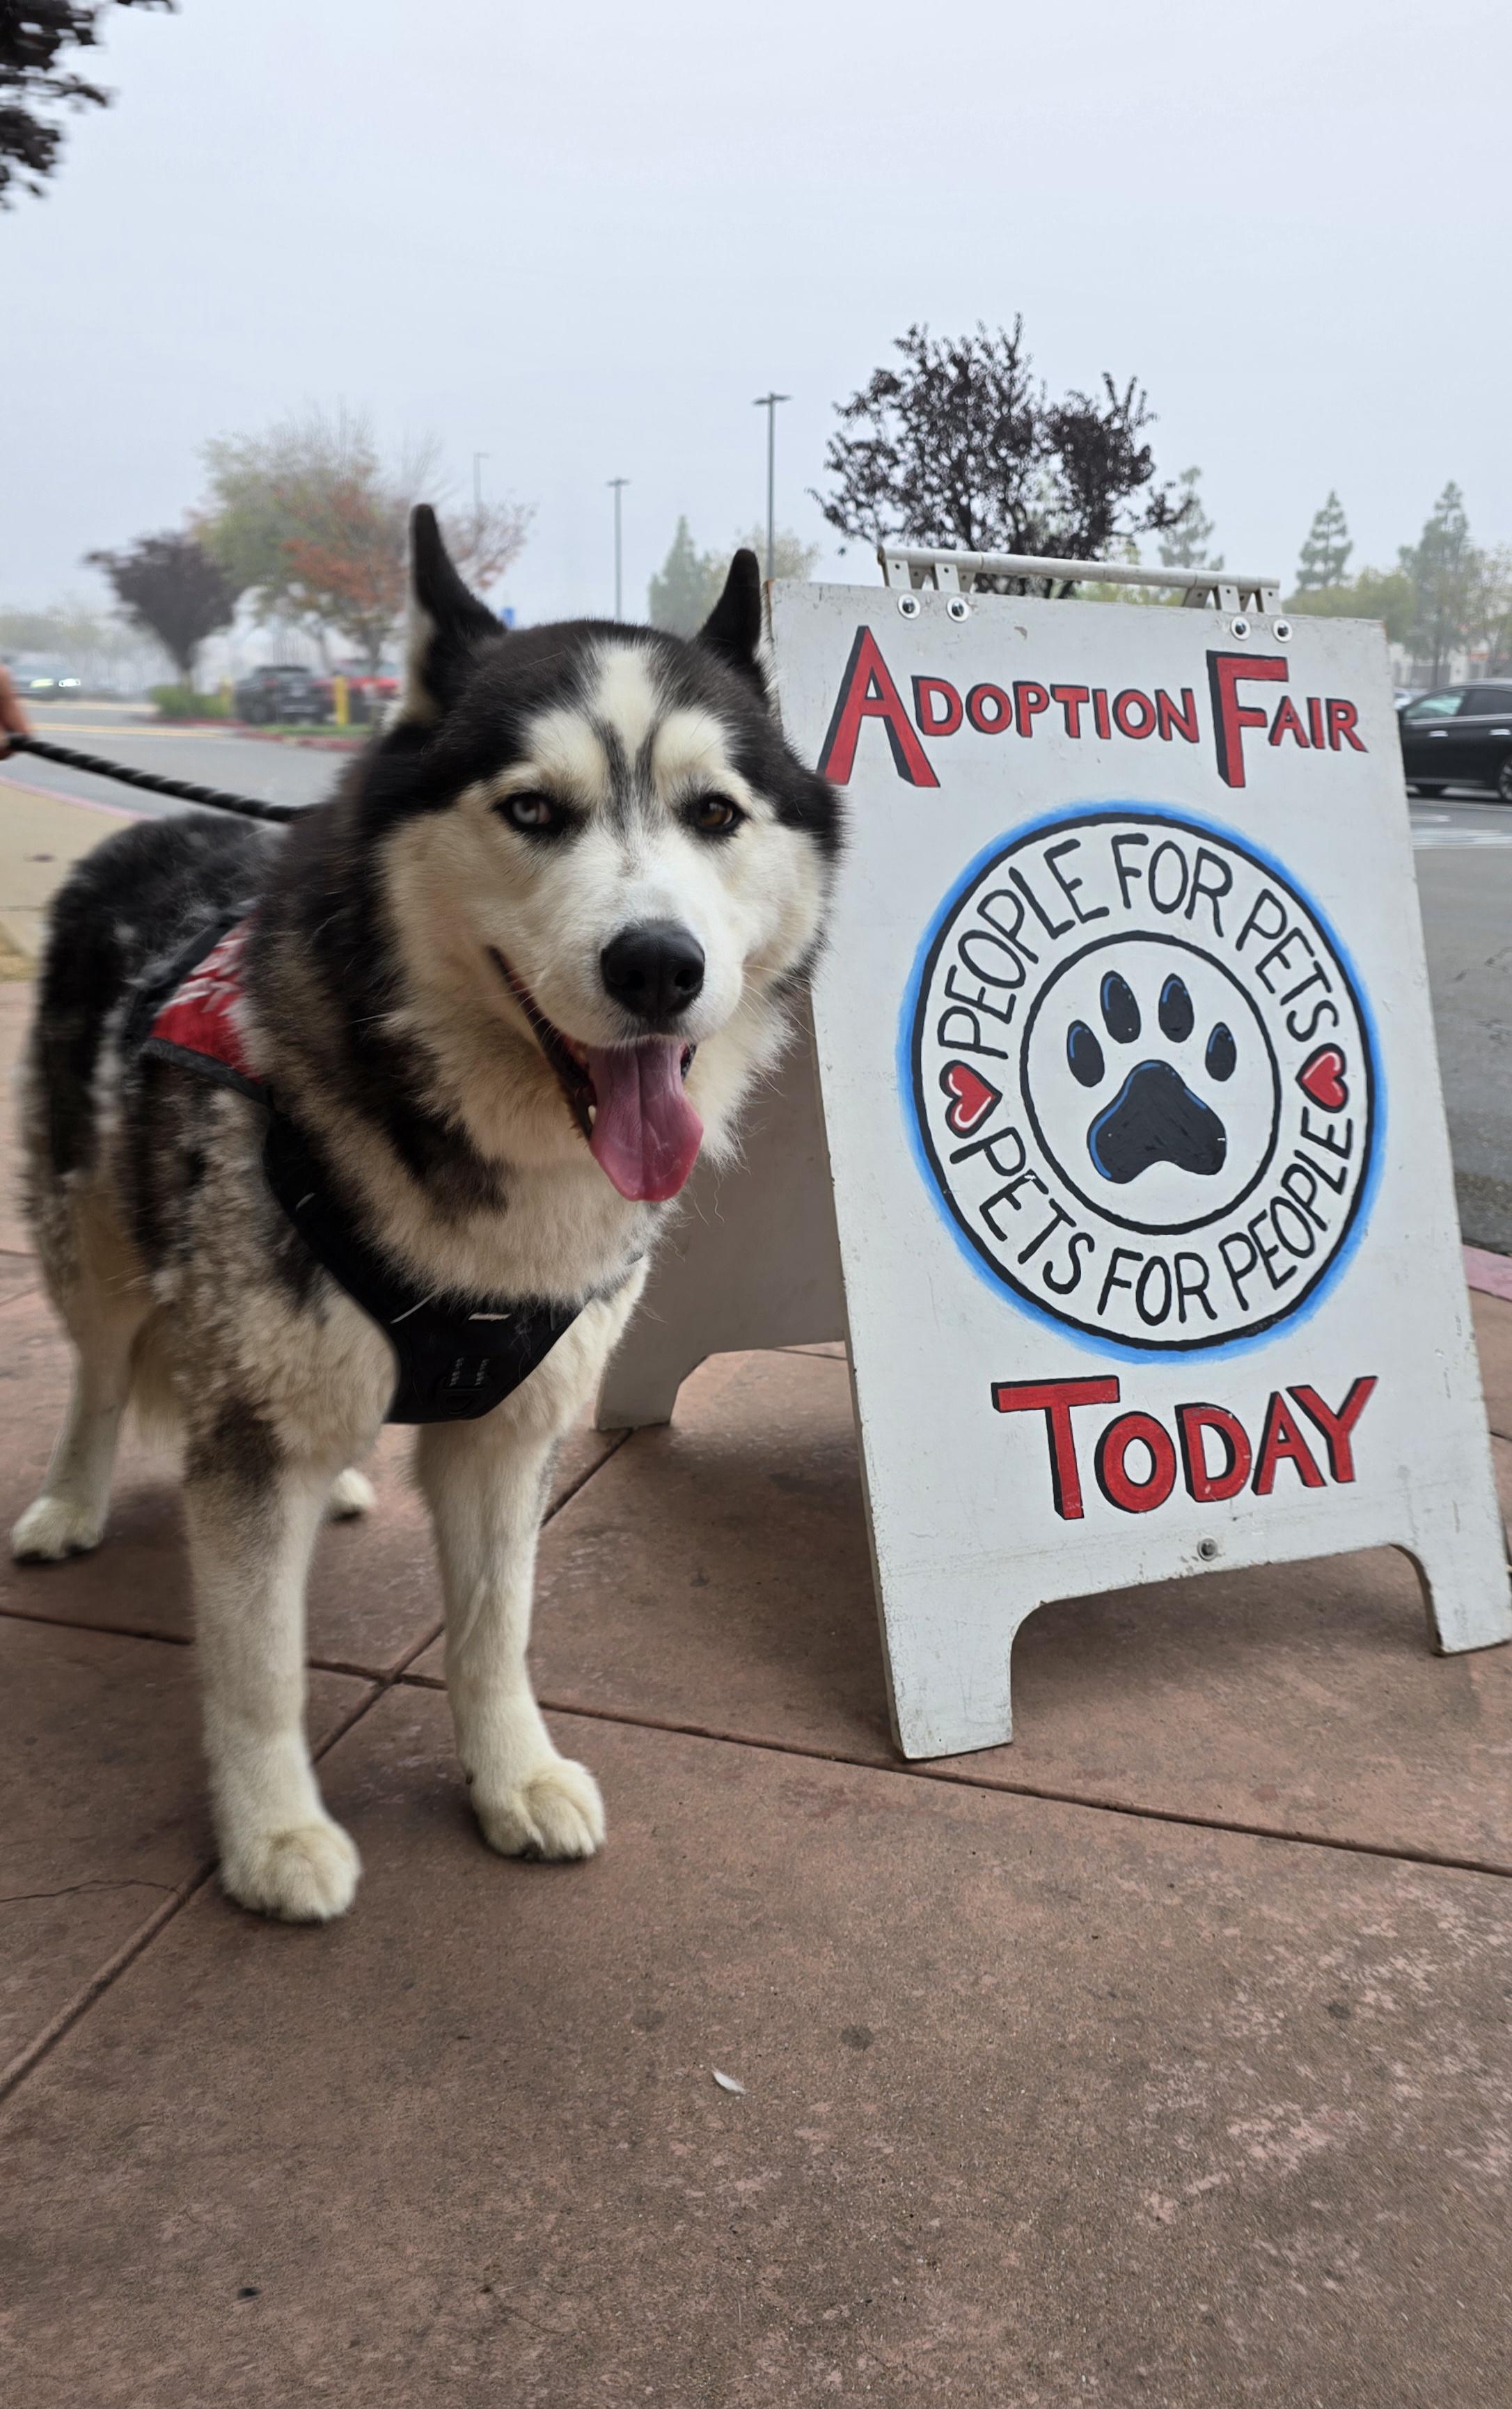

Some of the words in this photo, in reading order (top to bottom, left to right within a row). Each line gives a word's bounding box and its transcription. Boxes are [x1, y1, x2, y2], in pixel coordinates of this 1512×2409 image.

[816, 625, 1200, 787] ADOPTION
[1206, 650, 1369, 787] FAIR
[937, 838, 1110, 1060] PEOPLE
[1111, 833, 1233, 938] FOR
[1236, 889, 1339, 1042] PETS
[950, 1126, 1095, 1295] PETS
[1097, 1247, 1218, 1326] FOR
[1218, 1106, 1354, 1311] PEOPLE
[991, 1375, 1379, 1521] TODAY
